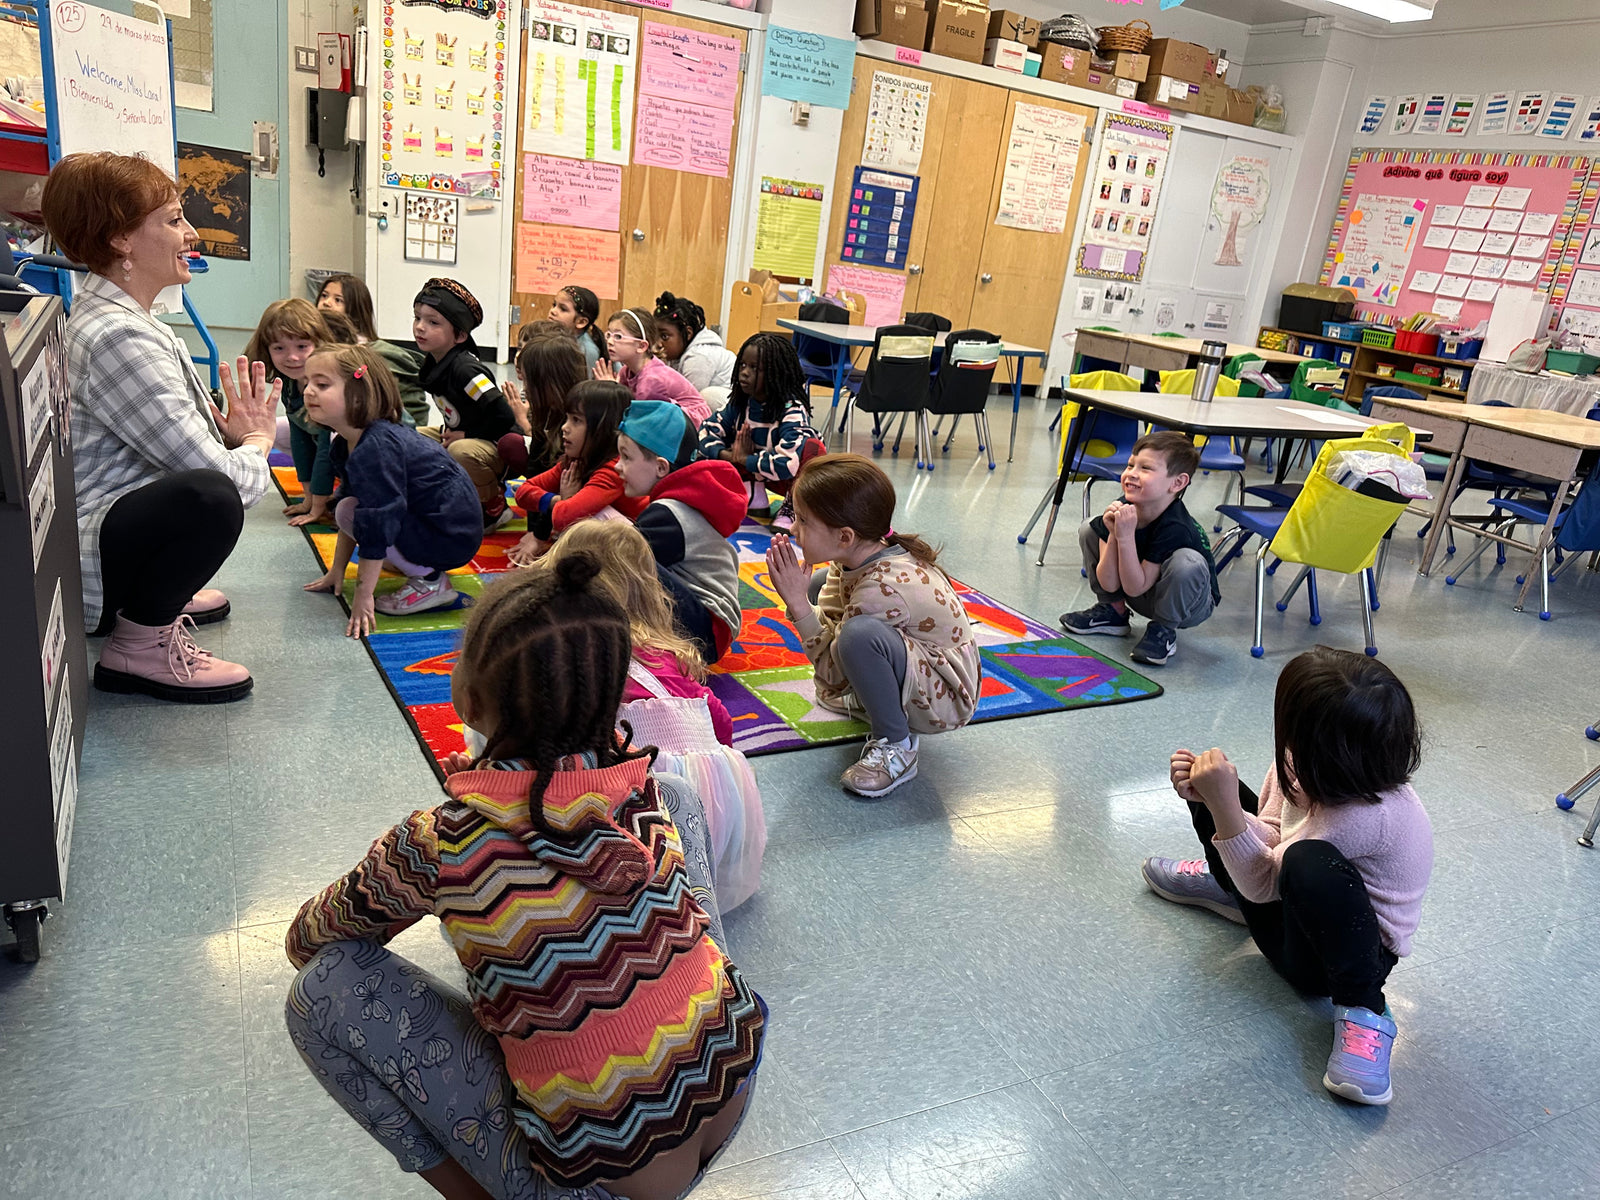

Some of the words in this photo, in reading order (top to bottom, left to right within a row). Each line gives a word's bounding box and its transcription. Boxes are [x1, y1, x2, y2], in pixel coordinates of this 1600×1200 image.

[60, 6, 80, 24] 125
[115, 20, 122, 34] de
[124, 27, 142, 40] marzo
[152, 34, 165, 45] 2023
[946, 25, 976, 38] FRAGILE
[769, 47, 780, 58] How
[874, 74, 901, 86] SONIDOS
[902, 81, 929, 92] INICIALES
[1384, 167, 1419, 178] ¡Adivina
[1425, 170, 1443, 180] qué
[1450, 170, 1479, 181] figura
[1486, 172, 1506, 183] soy!
